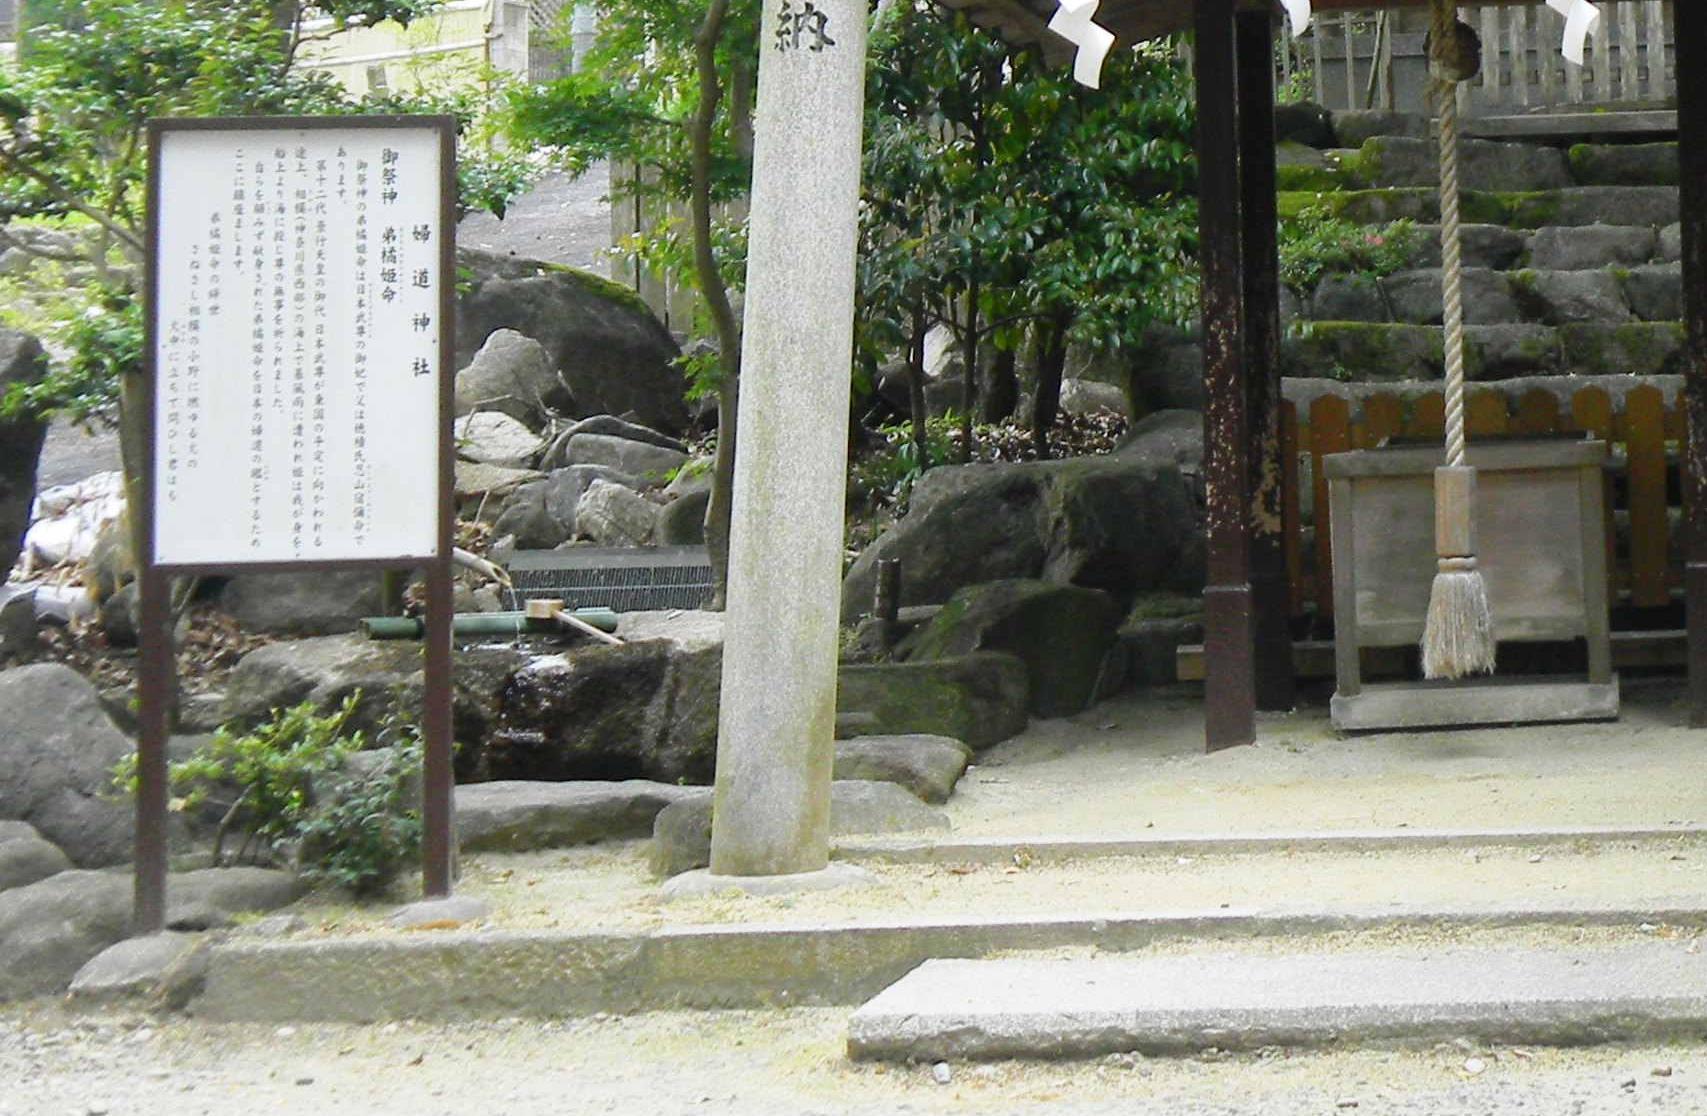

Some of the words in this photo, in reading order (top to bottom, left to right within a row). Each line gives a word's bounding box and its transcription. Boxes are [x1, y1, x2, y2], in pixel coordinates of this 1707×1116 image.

[774, 0, 835, 53] 納
[411, 223, 432, 377] 婦道神社
